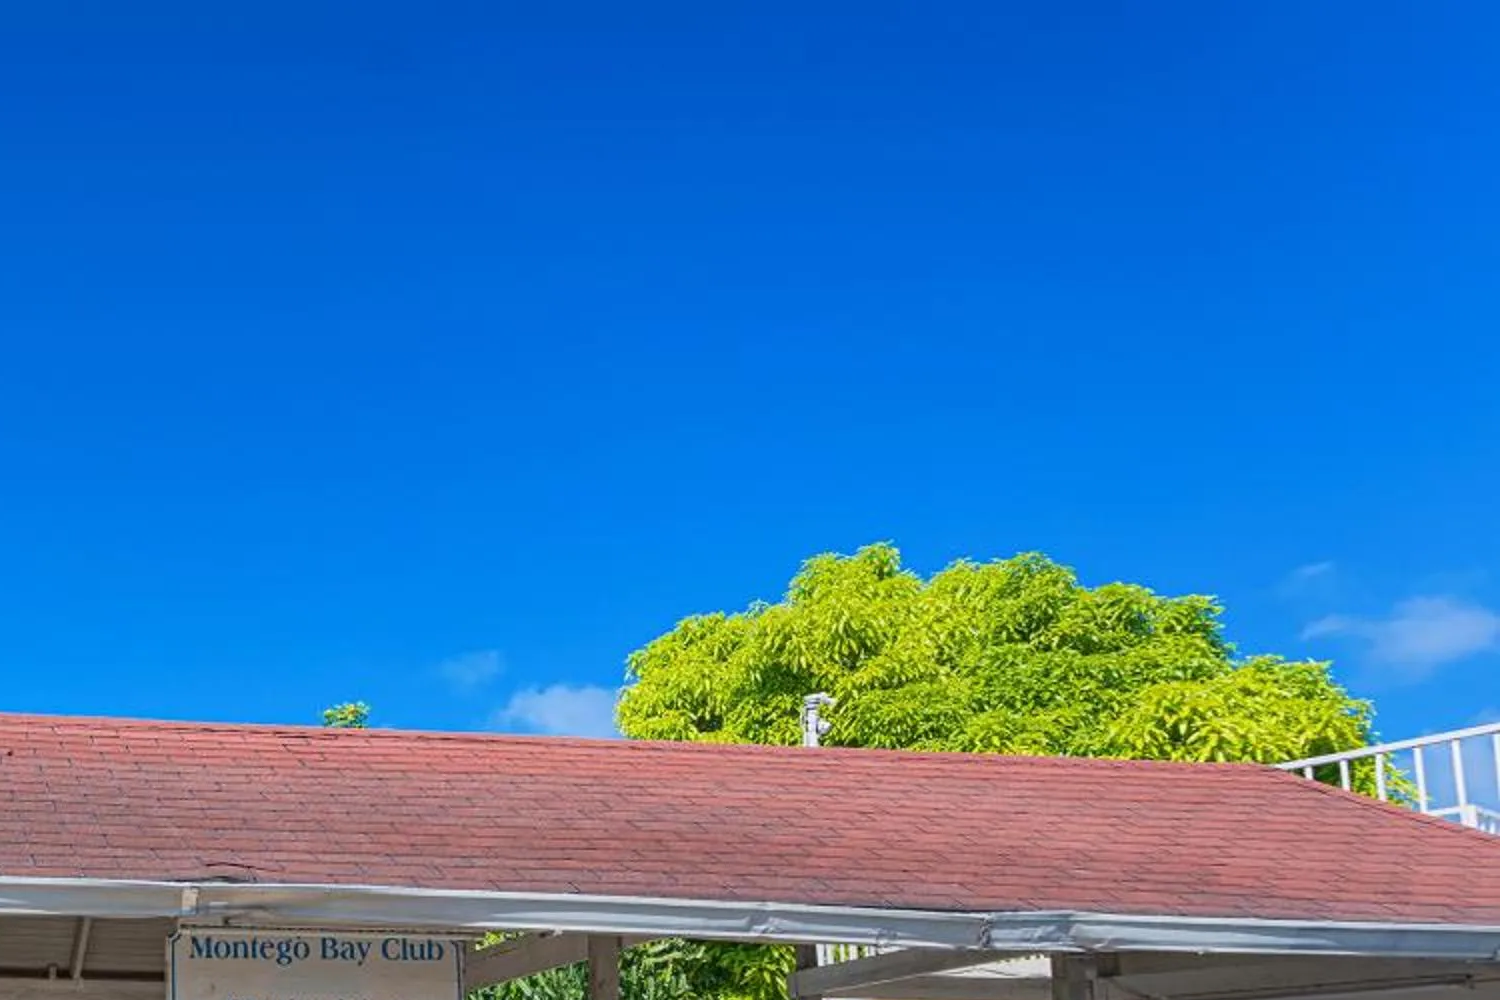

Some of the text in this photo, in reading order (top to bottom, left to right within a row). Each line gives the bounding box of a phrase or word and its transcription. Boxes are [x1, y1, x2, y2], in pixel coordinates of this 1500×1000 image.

[189, 936, 444, 966] Montego Bay Club
